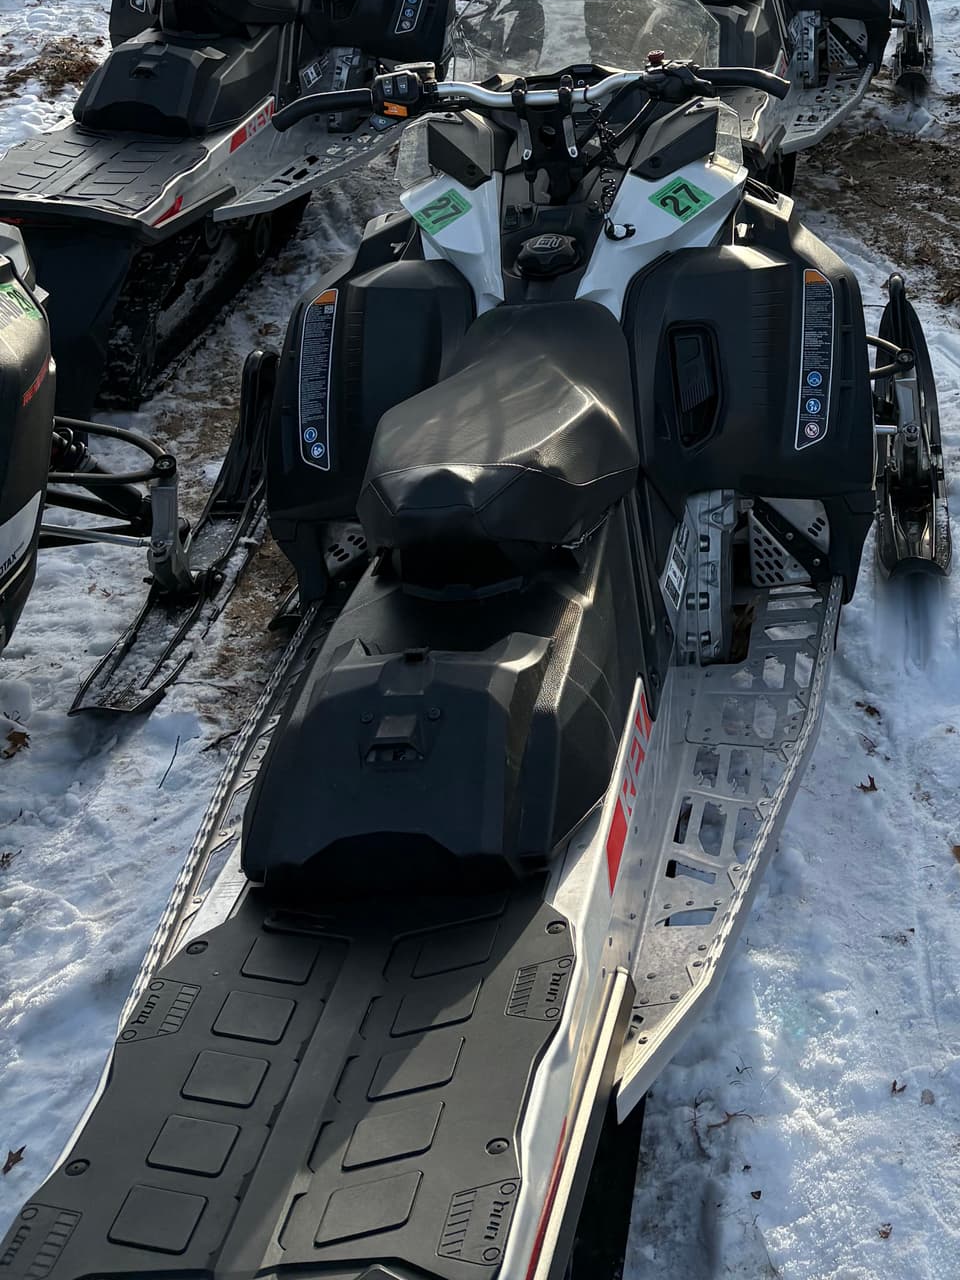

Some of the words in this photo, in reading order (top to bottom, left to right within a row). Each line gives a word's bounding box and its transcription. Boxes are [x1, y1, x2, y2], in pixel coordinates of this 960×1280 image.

[245, 104, 273, 139] REV
[421, 197, 463, 225] 27
[660, 183, 701, 217] 27
[621, 698, 653, 818] REV
